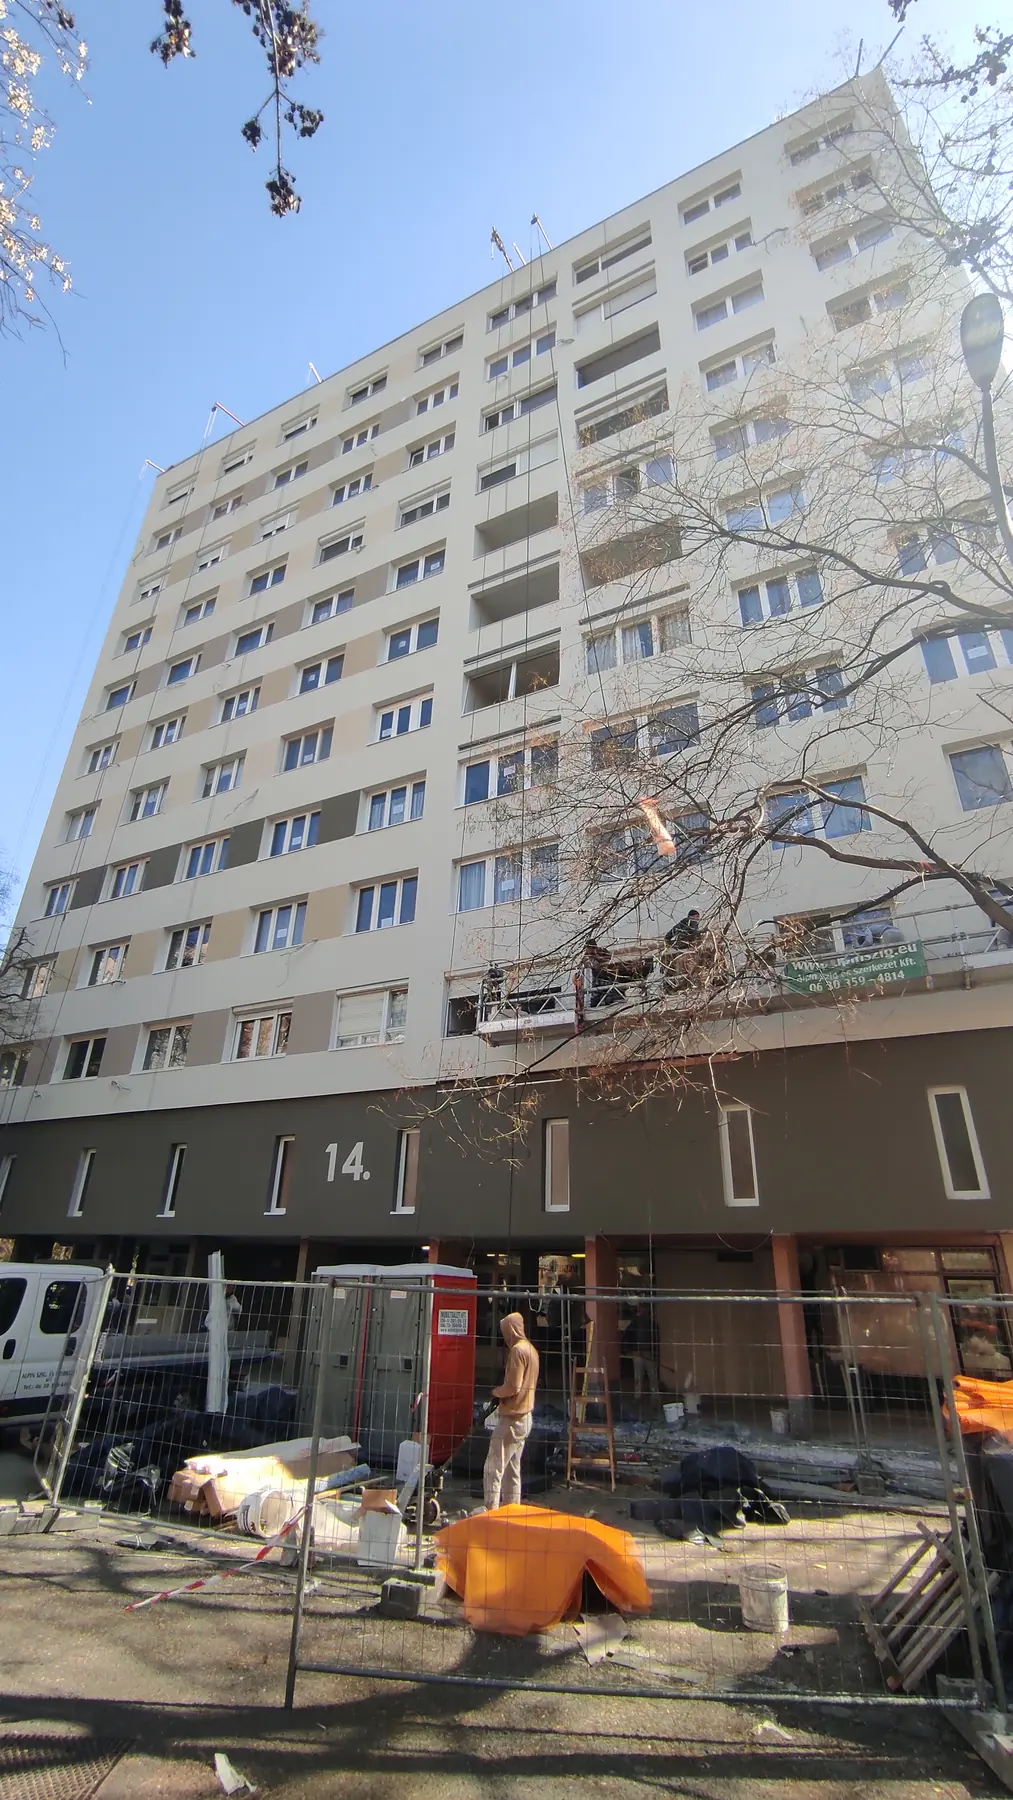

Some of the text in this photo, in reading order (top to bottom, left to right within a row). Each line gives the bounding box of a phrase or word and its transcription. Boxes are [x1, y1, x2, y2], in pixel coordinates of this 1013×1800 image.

[853, 960, 898, 975] Szerkezet
[900, 957, 917, 967] Kft.
[809, 982, 823, 992] 06
[877, 970, 905, 984] 4814
[325, 1142, 370, 1182] 14.
